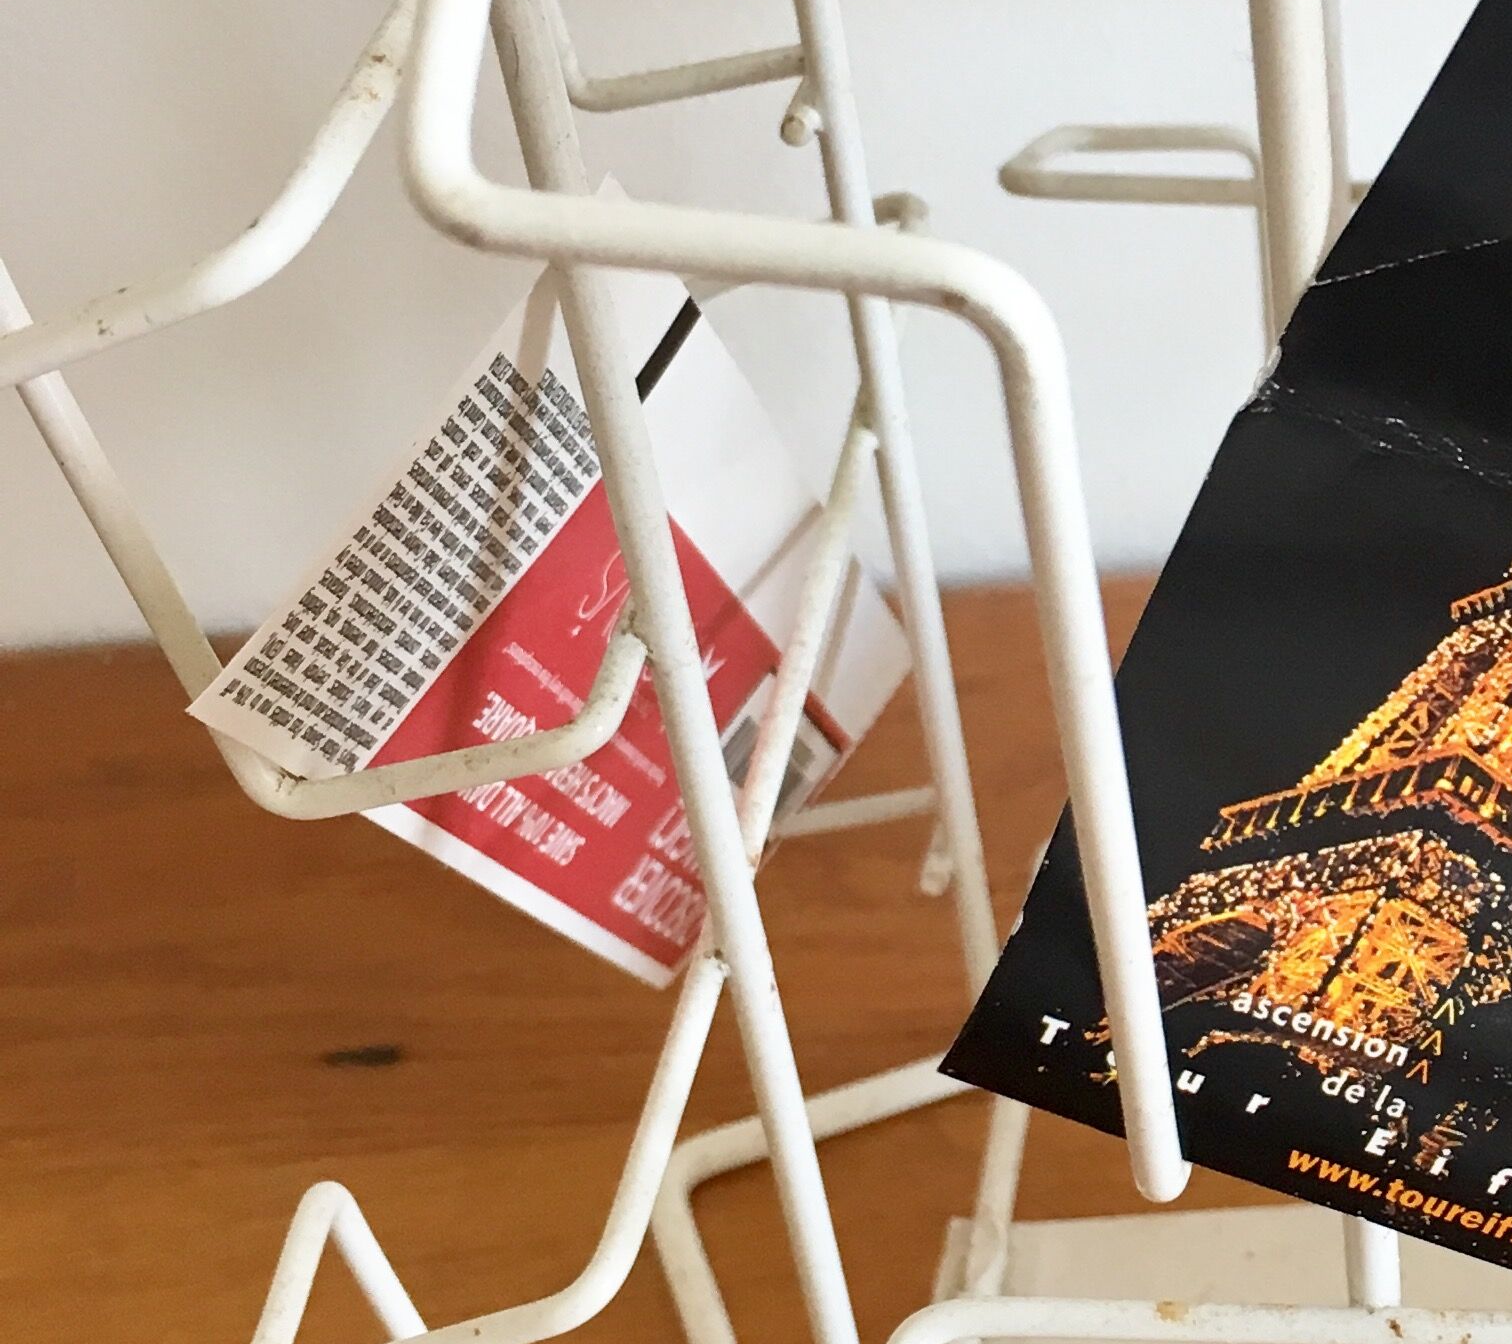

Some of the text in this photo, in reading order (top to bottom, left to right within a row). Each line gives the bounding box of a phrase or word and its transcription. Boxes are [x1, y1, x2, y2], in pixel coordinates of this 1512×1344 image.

[471, 690, 537, 743] QUARE.
[487, 784, 531, 831] ALL
[1231, 989, 1409, 1067] ascension
[1321, 1073, 1407, 1118] de la
